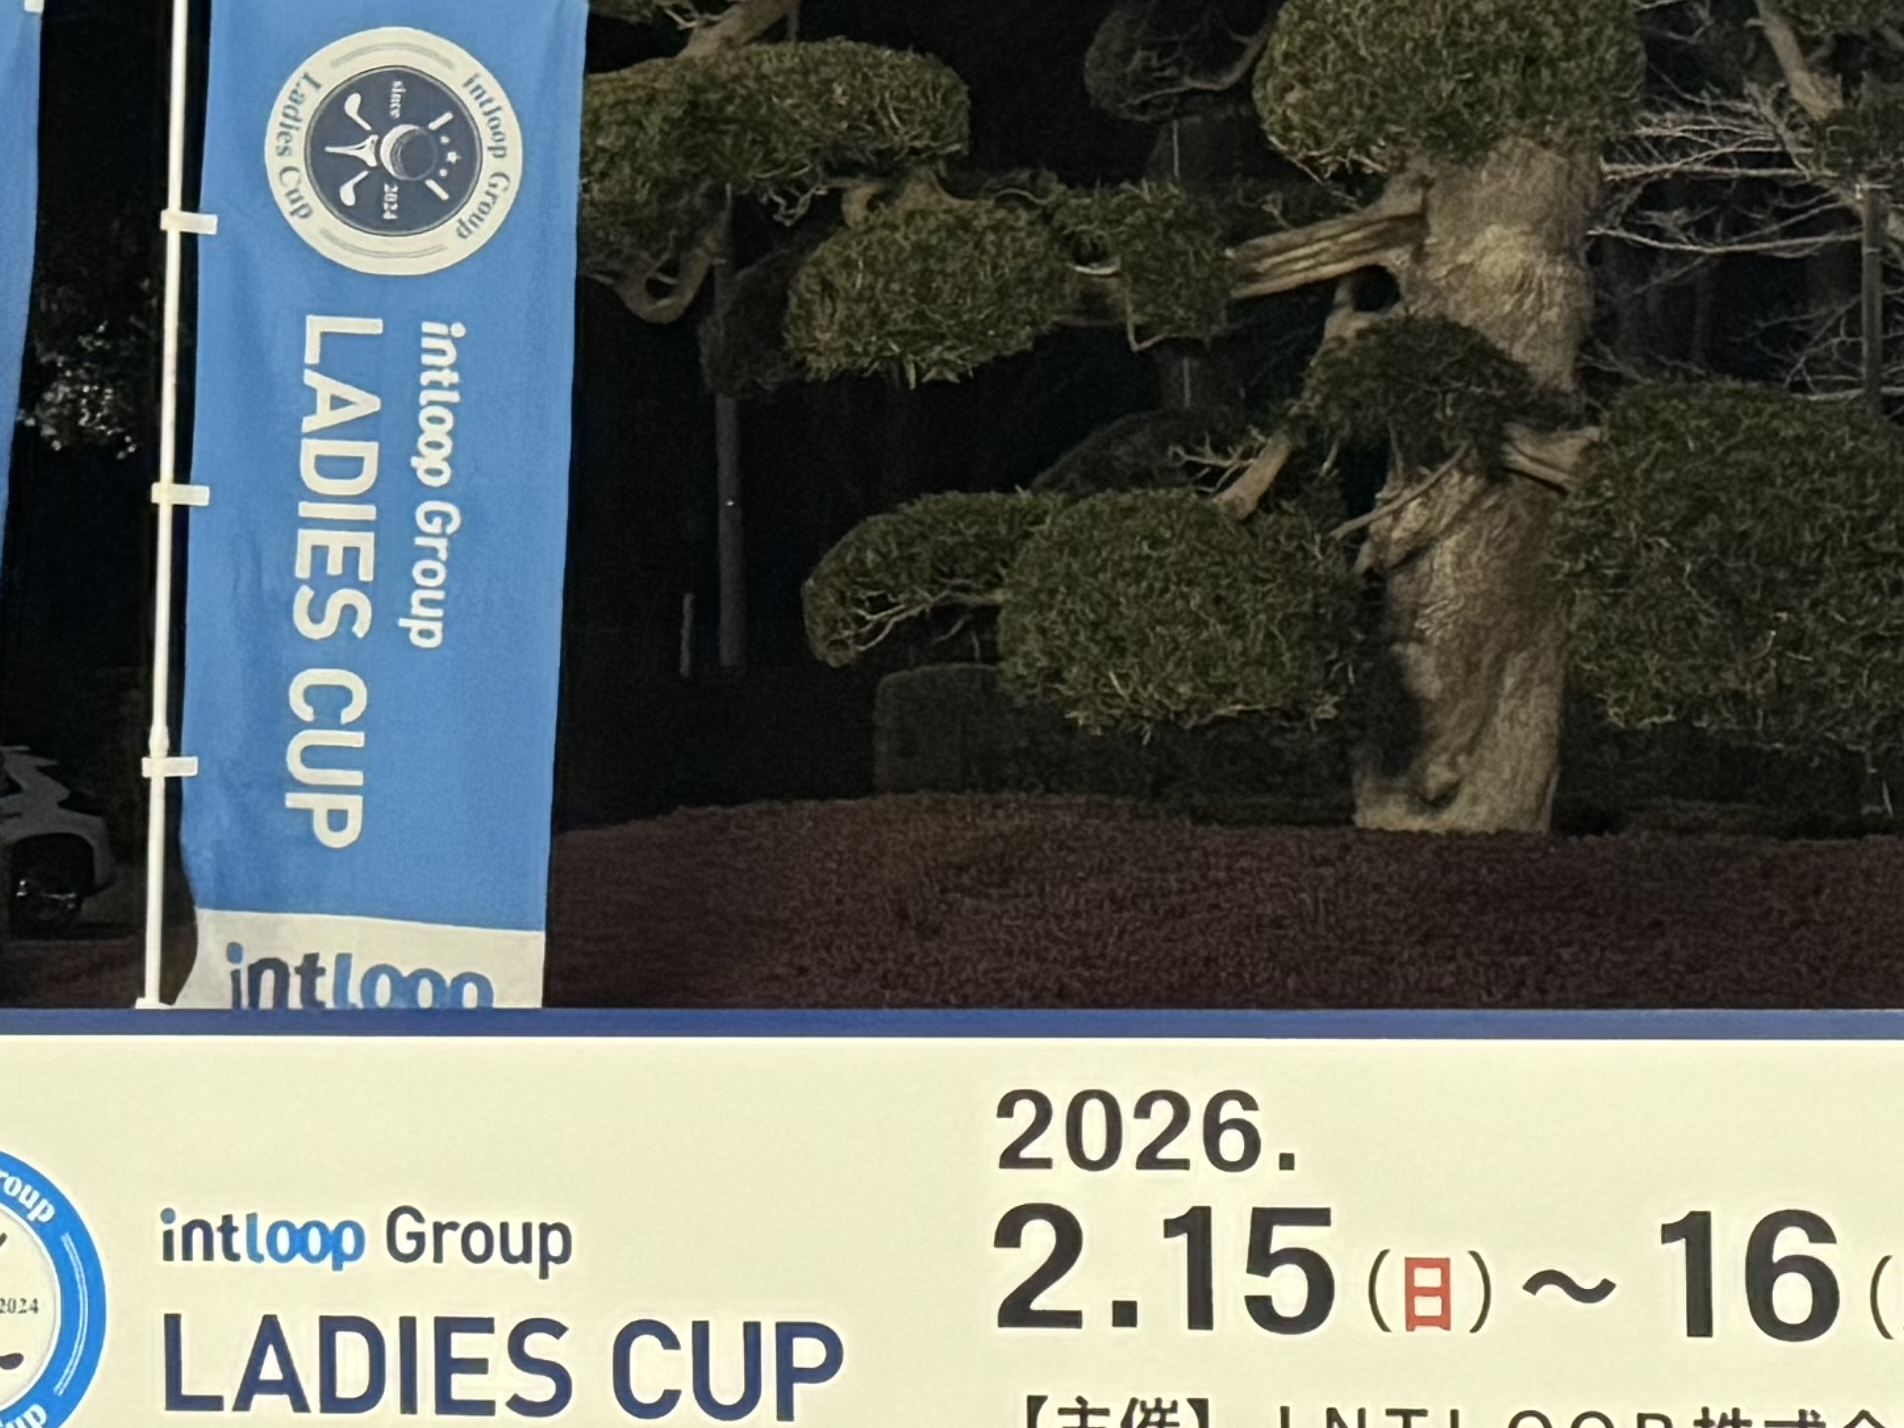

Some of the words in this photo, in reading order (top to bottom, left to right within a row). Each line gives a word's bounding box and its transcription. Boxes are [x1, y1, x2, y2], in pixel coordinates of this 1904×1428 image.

[276, 72, 322, 157] Ladies
[279, 166, 314, 220] Cup
[456, 171, 511, 239] Group
[410, 321, 467, 488] intloop
[292, 314, 384, 641] LADIES
[397, 500, 462, 649] Group
[284, 667, 368, 849] CUP
[996, 1088, 1296, 1173] 2026.
[160, 1207, 366, 1272] intloop
[386, 1205, 573, 1280] Group
[163, 1312, 573, 1418] LADIES
[612, 1318, 844, 1423] CUP
